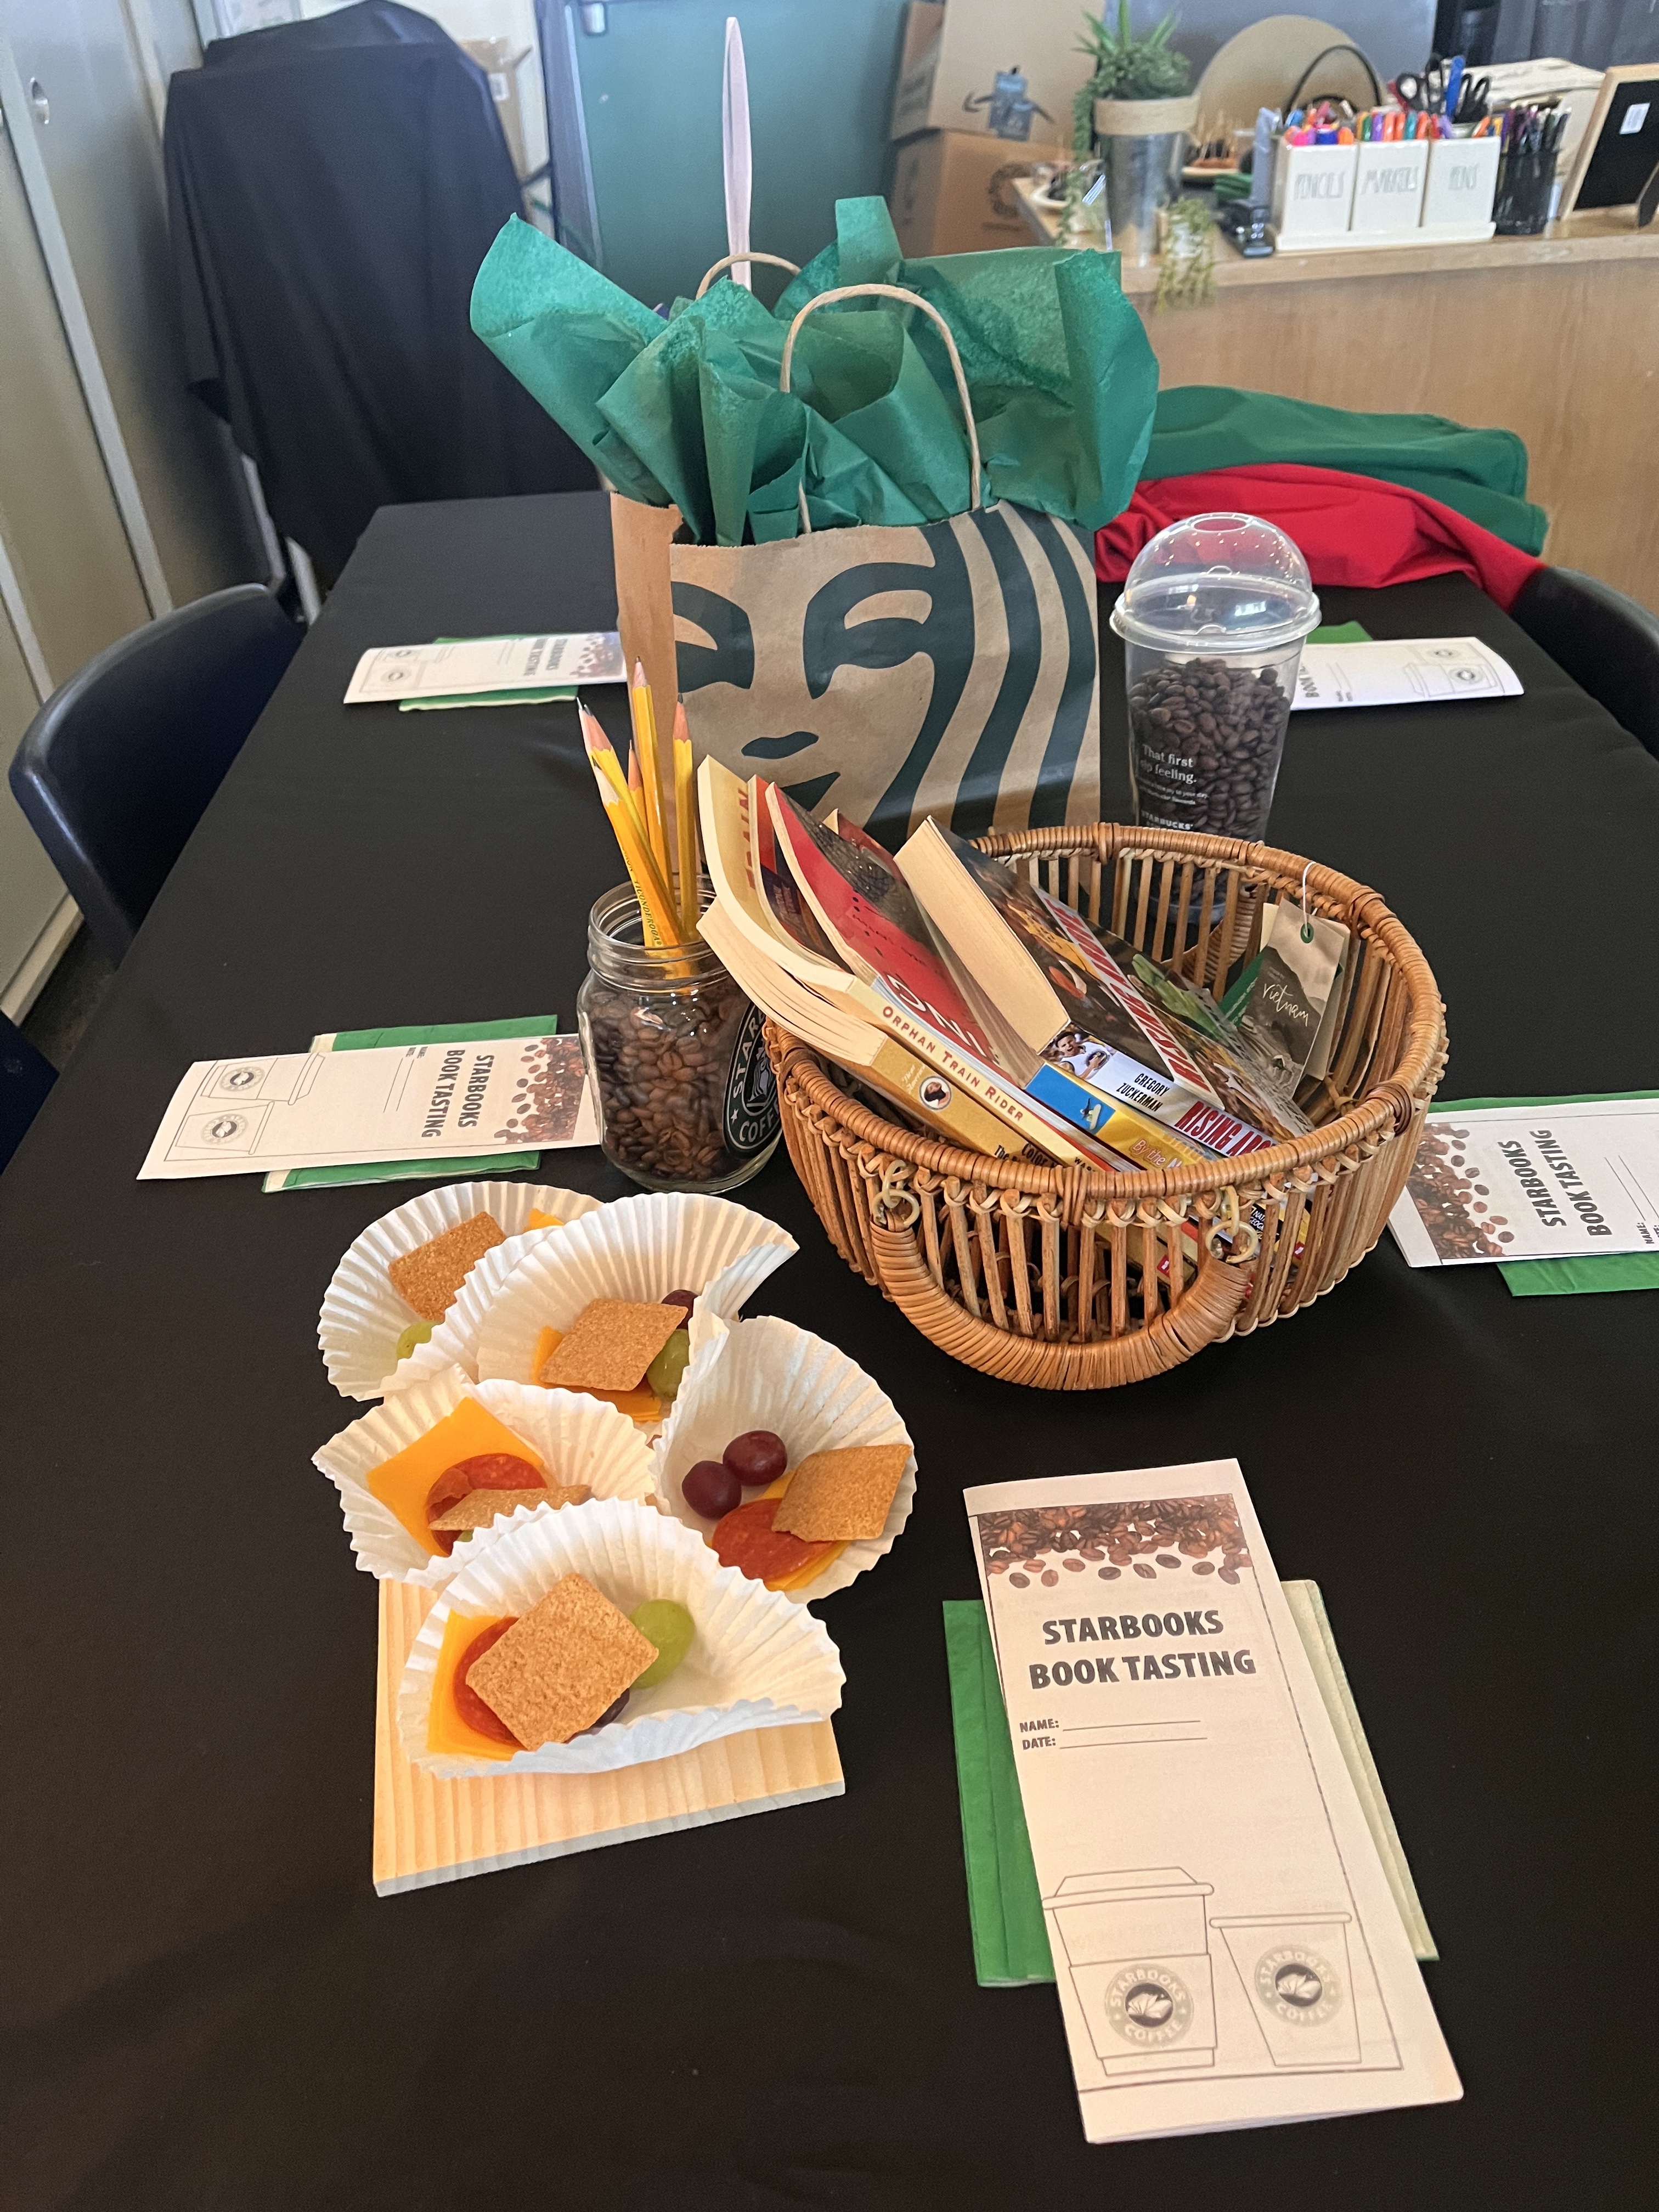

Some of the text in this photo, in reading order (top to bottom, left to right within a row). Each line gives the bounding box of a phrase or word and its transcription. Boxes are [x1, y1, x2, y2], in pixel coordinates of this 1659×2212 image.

[1143, 744, 1194, 768] That first
[1155, 764, 1197, 785] feeling.
[883, 1006, 936, 1054] ORPHAN
[942, 1051, 981, 1088] TRAIN
[985, 1085, 1024, 1121] RIDER
[421, 1049, 466, 1137] BOOK TASTING
[458, 1055, 495, 1127] STARBOOKS
[1116, 1082, 1163, 1112] ZUCKERMAN
[1134, 1073, 1170, 1097] GREGORY
[1174, 1101, 1243, 1150] RISING
[1133, 1139, 1150, 1155] By
[1147, 1149, 1166, 1166] the
[1497, 1140, 1567, 1227] STARBOOKS
[1529, 1130, 1612, 1235] BOOK TASTING
[1636, 1222, 1655, 1244] NAME:
[1042, 1610, 1224, 1645] STARBOOKS
[1029, 1649, 1257, 1690] BOOK TASTING
[1019, 1718, 1059, 1733] NAME:
[1022, 1736, 1056, 1750] DATE:
[1110, 1968, 1187, 2007] STARBOOKS
